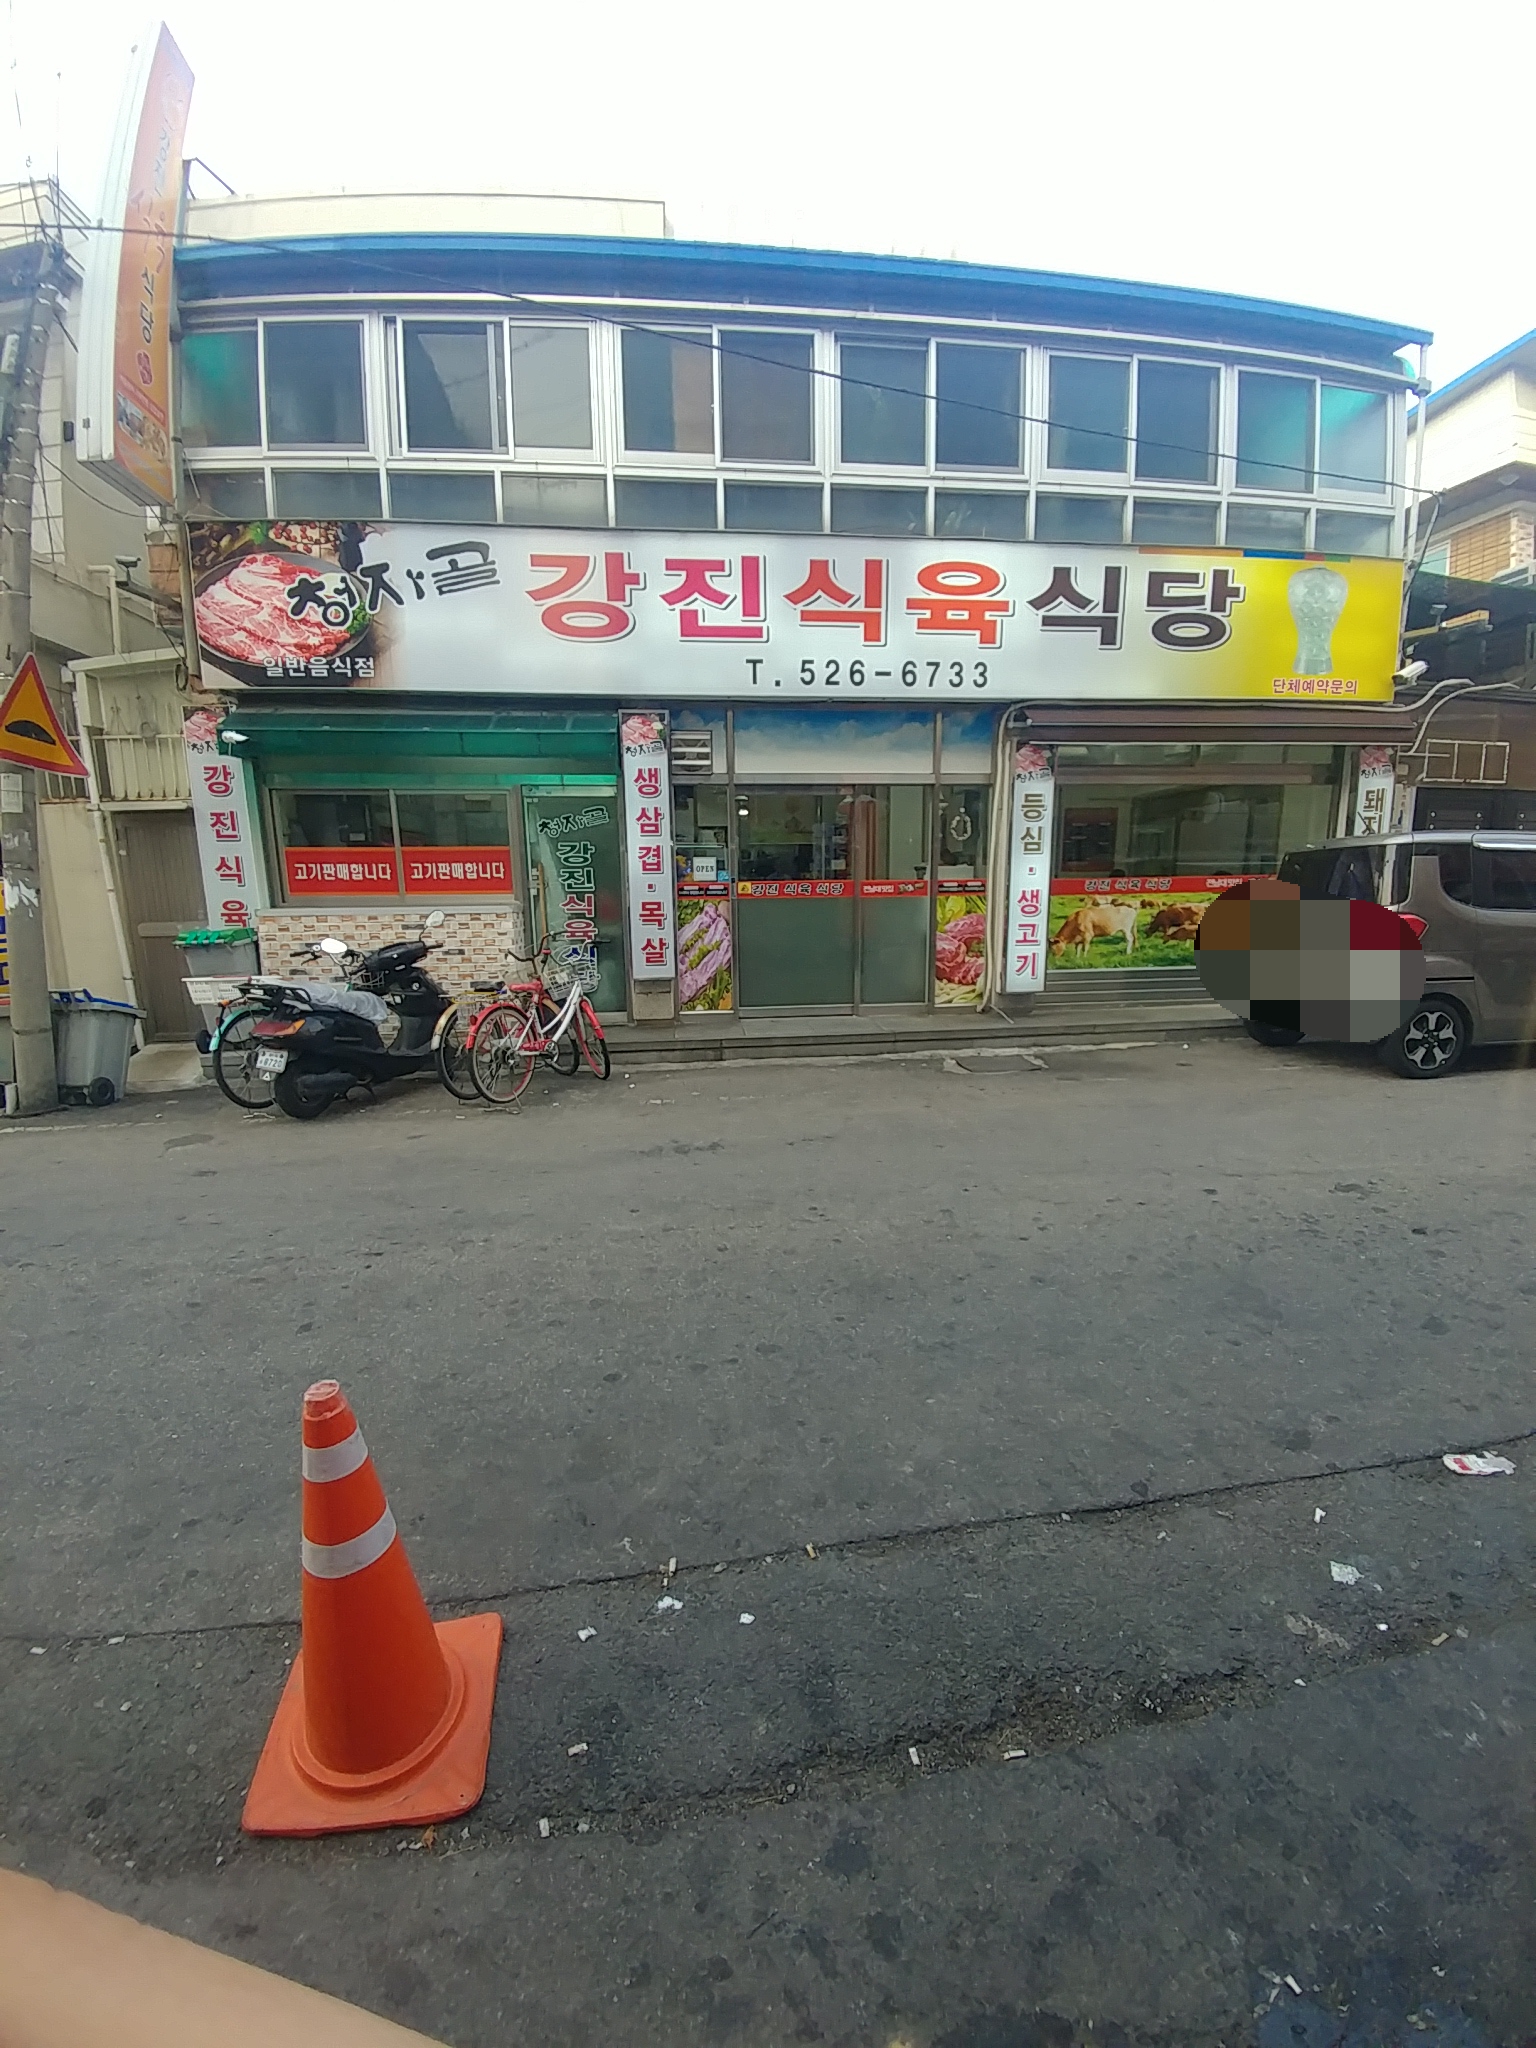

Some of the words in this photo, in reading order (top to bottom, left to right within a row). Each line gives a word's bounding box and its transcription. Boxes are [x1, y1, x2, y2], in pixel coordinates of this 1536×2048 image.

[287, 540, 501, 629] 청자골
[525, 551, 1246, 652] 강진식육식당
[263, 656, 376, 678] 일반음식점
[1273, 677, 1359, 696] 단체예약문의
[624, 740, 665, 758] 청자골
[538, 805, 610, 838] 청자골
[294, 863, 392, 881] 고기판매합니다
[410, 861, 505, 880] 고기판매합니다
[695, 865, 715, 873] OPEN
[751, 883, 779, 896] 강진
[784, 883, 812, 896] 식육
[816, 883, 844, 895] 식당
[1085, 879, 1110, 891] 강진
[1115, 879, 1141, 890] 식육
[1145, 877, 1172, 889] 식당
